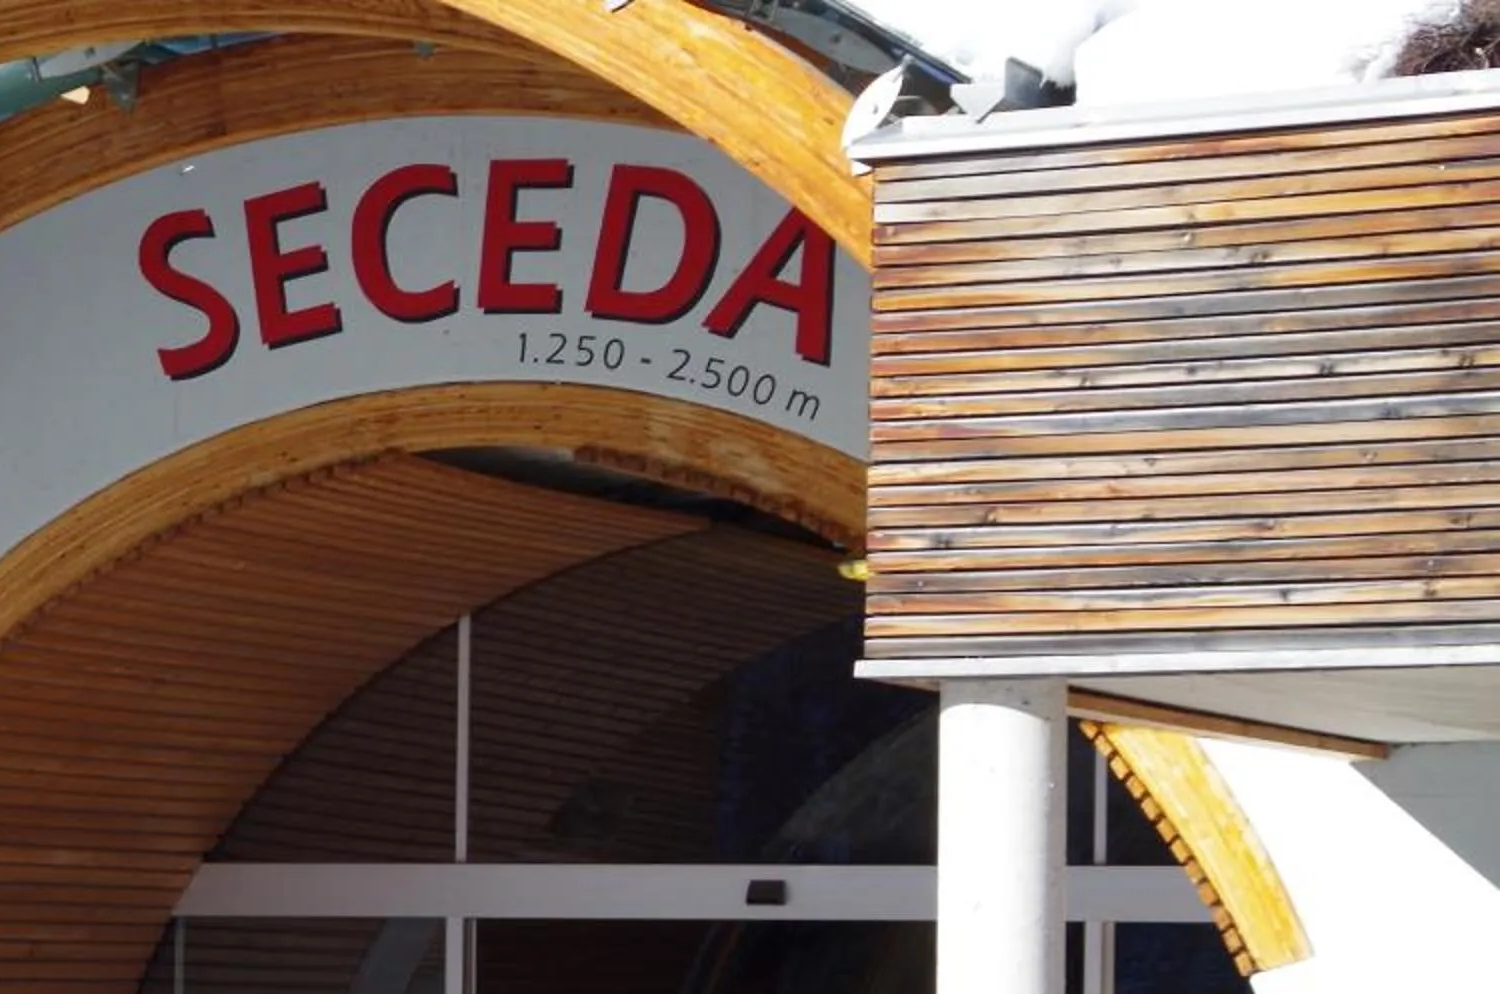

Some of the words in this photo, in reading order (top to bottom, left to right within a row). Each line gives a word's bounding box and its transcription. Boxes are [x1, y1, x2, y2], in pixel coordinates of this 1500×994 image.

[138, 158, 835, 380] SECEDA
[516, 332, 624, 370] 1.250
[666, 346, 777, 407] 2.500
[785, 387, 822, 420] m
